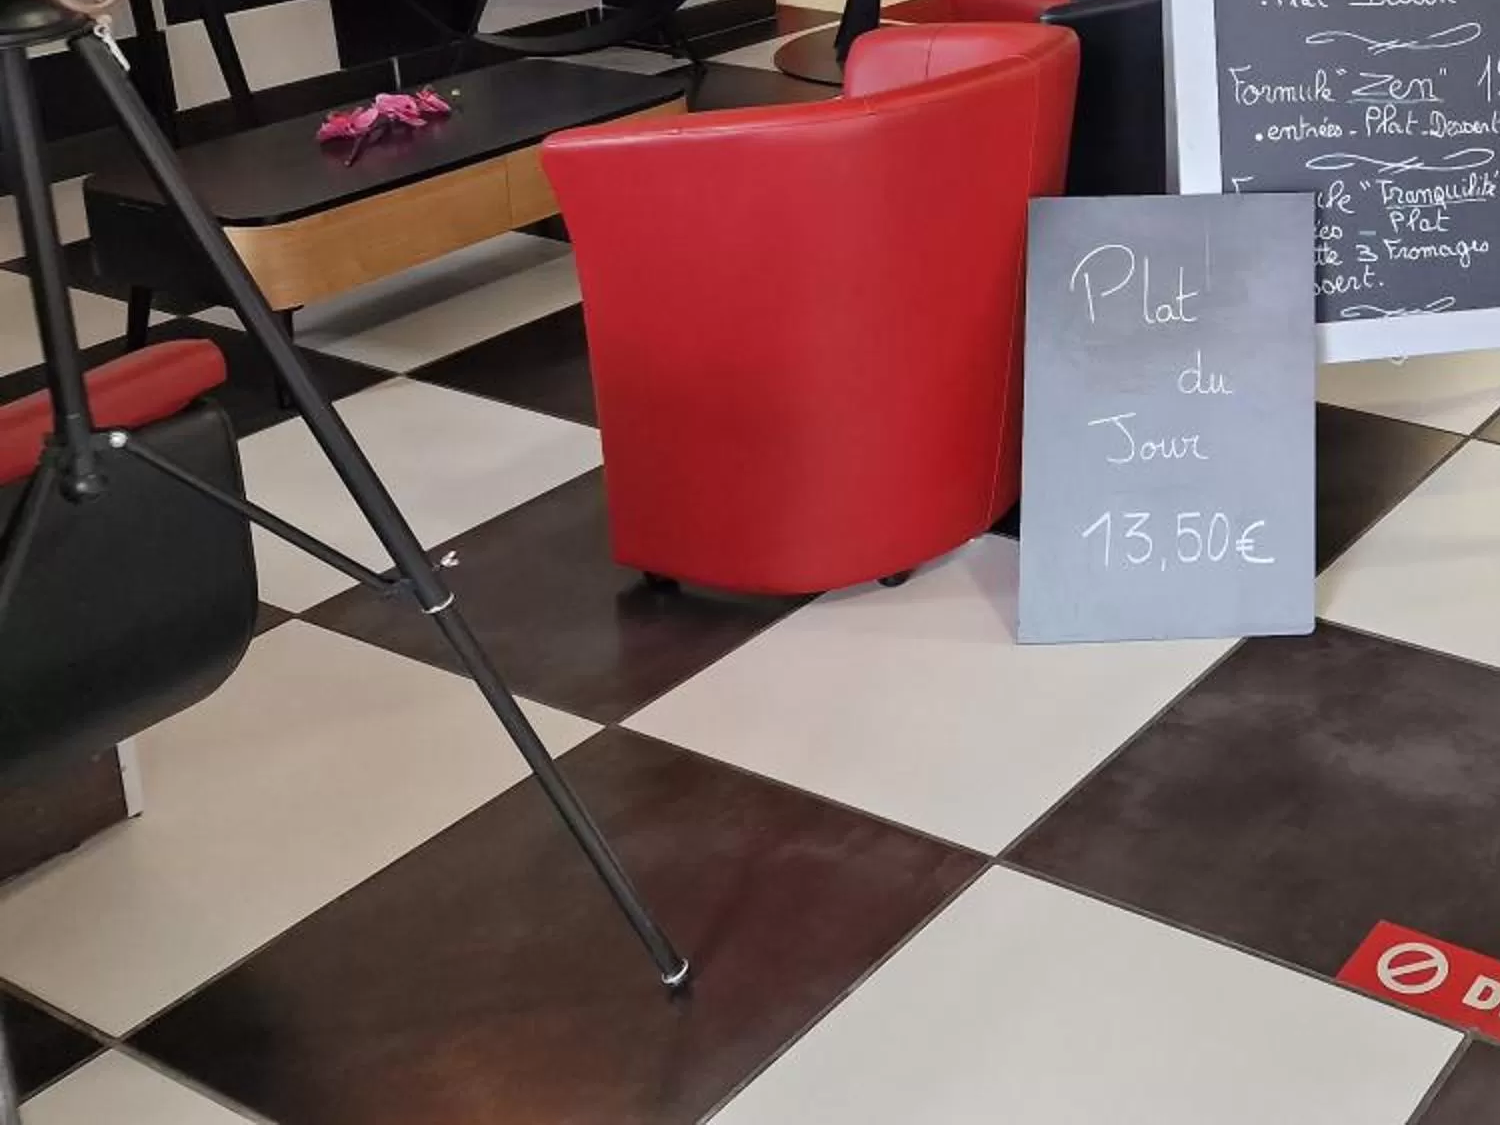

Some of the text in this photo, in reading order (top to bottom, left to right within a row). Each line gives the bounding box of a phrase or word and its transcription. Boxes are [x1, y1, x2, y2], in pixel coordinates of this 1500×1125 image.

[1227, 65, 1337, 105] Formule
[1364, 107, 1419, 137] Plat
[1389, 208, 1451, 234] Plat
[1383, 237, 1490, 268] Fromages
[1069, 243, 1199, 324] Plat
[1178, 350, 1233, 395] du
[1088, 411, 1209, 464] Jour
[1082, 510, 1275, 572] 13,50€
